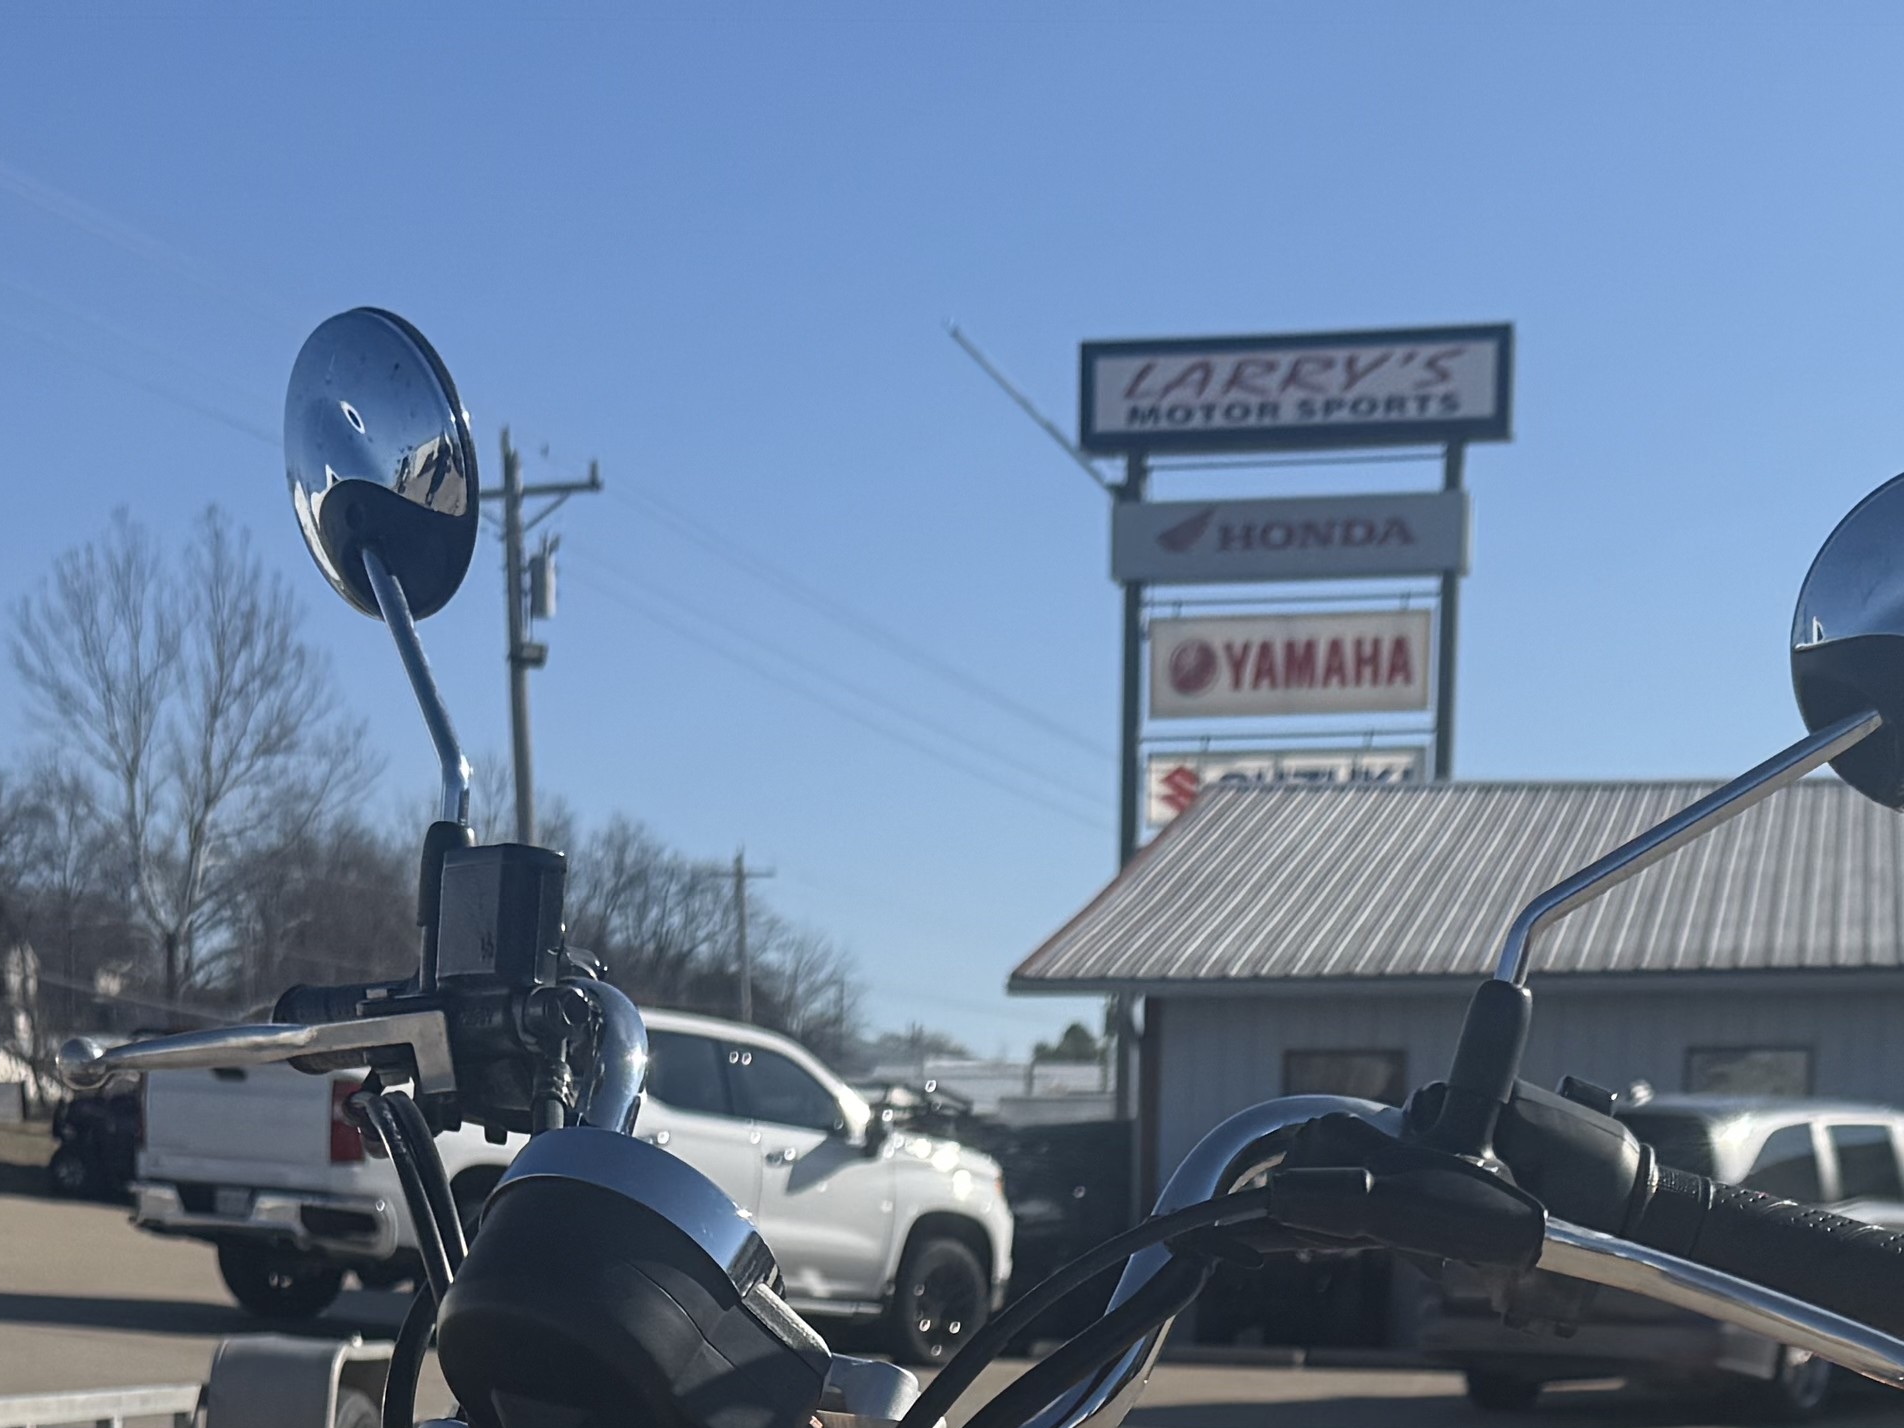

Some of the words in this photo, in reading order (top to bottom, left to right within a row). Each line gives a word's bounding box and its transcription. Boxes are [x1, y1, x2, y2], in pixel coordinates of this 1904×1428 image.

[1123, 347, 1466, 401] LARRY'S
[1126, 399, 1281, 429] MOTOR
[1297, 391, 1461, 422] SPORTS
[1215, 514, 1418, 553] HONDA
[1223, 634, 1414, 692] YAMAHA
